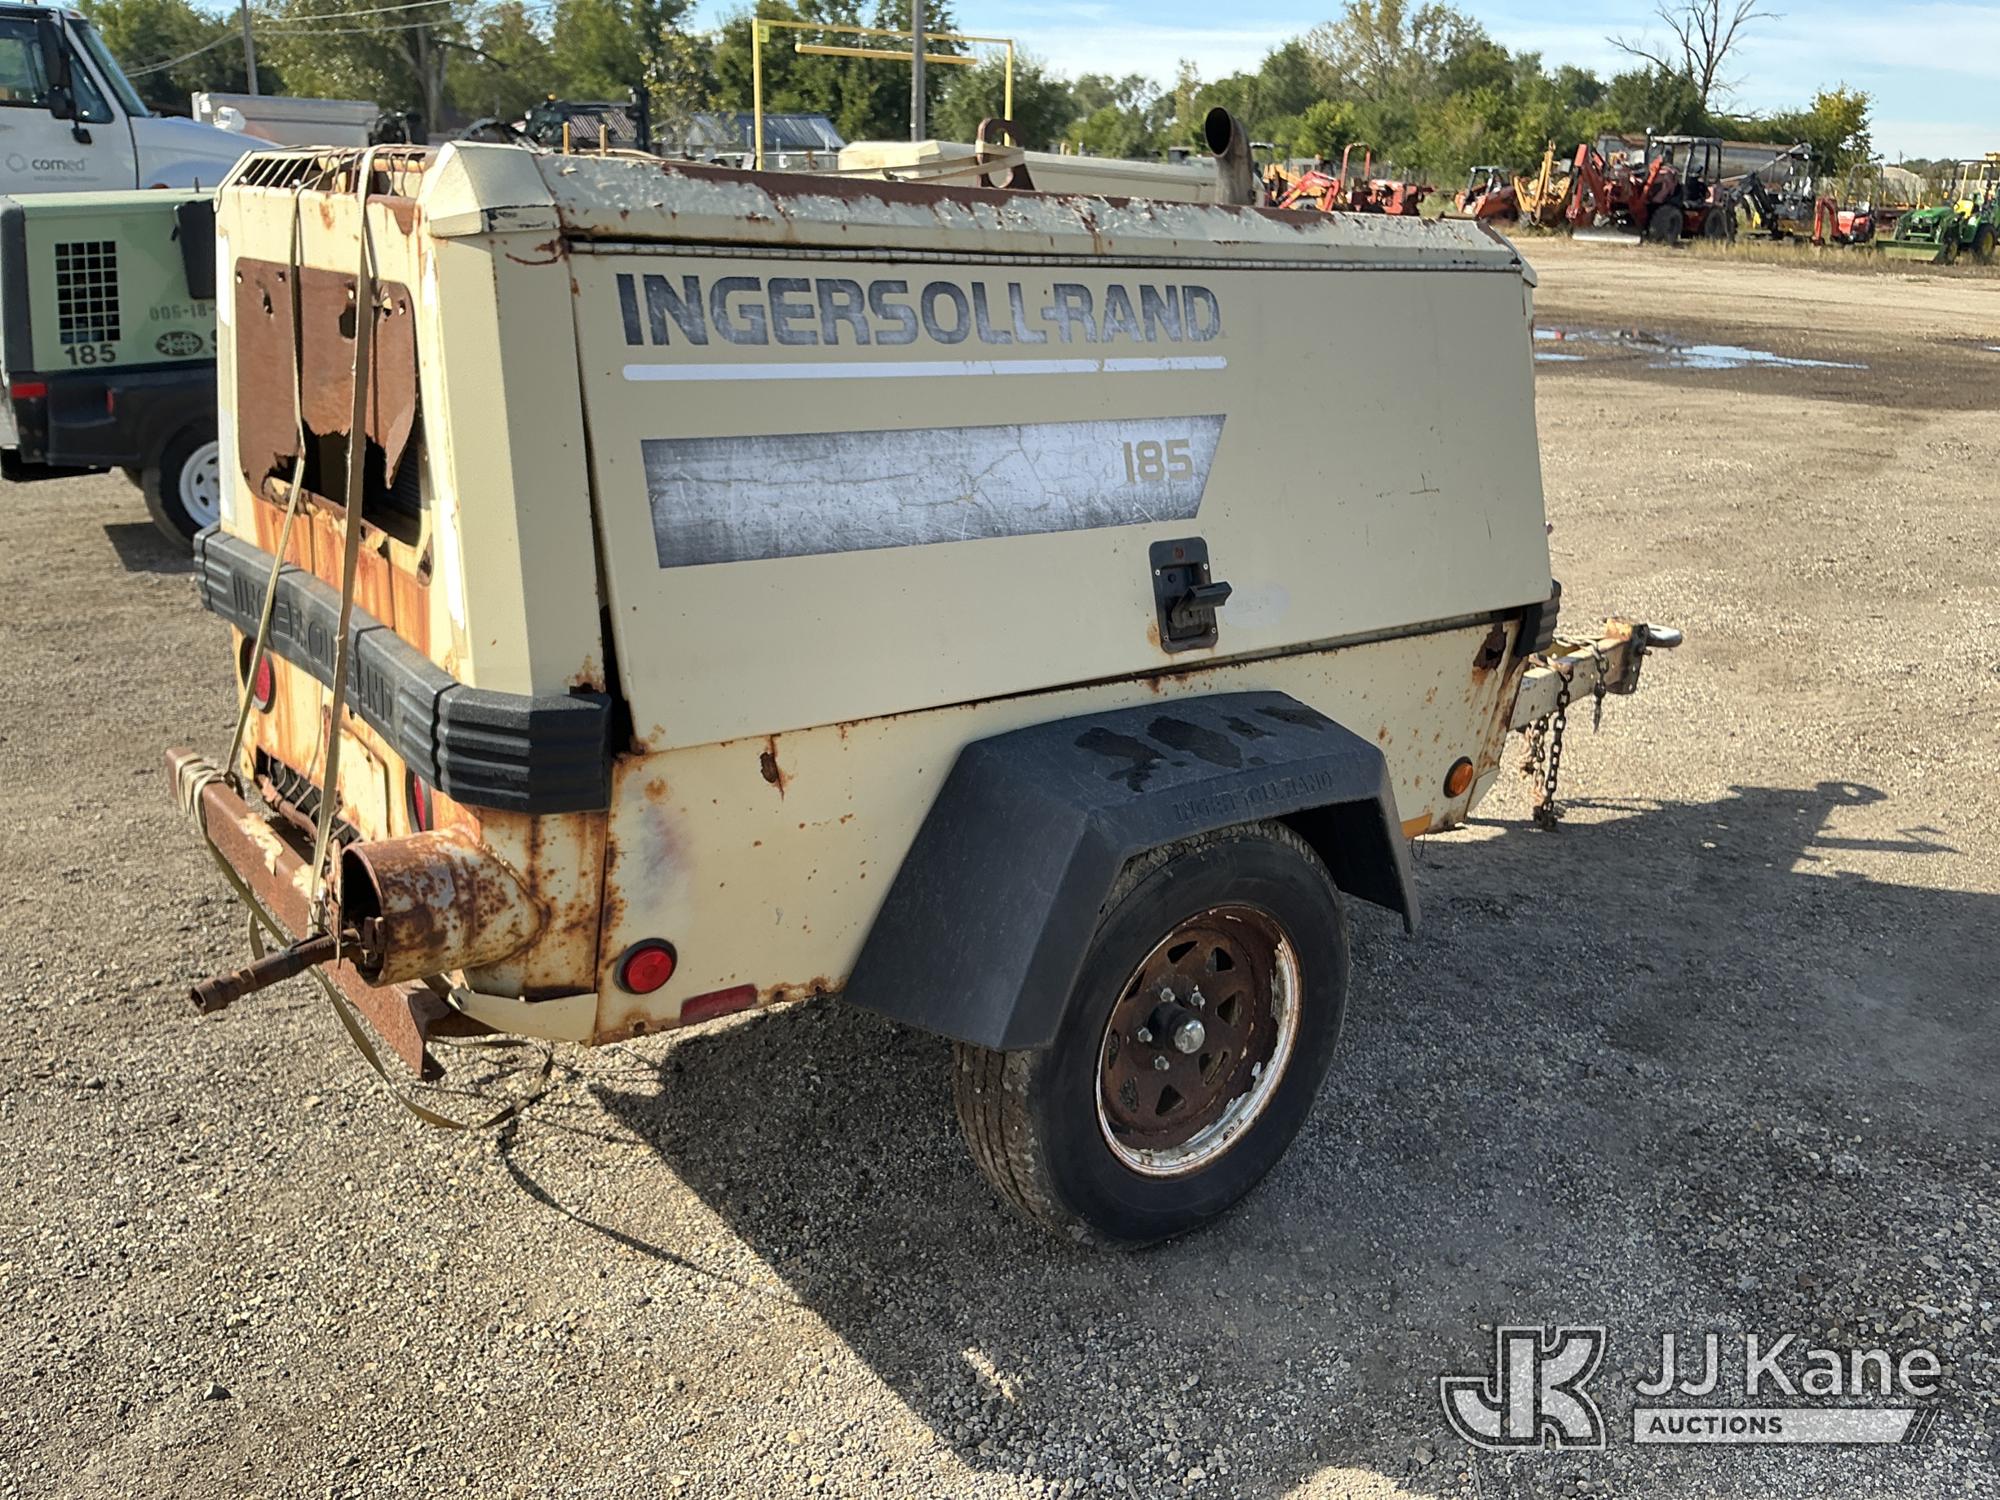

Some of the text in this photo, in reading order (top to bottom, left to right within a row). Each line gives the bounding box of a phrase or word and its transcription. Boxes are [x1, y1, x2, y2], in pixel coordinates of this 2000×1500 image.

[616, 272, 1222, 346] INGERSOLL-RAND
[64, 343, 116, 366] 185
[1122, 439, 1193, 485] 185
